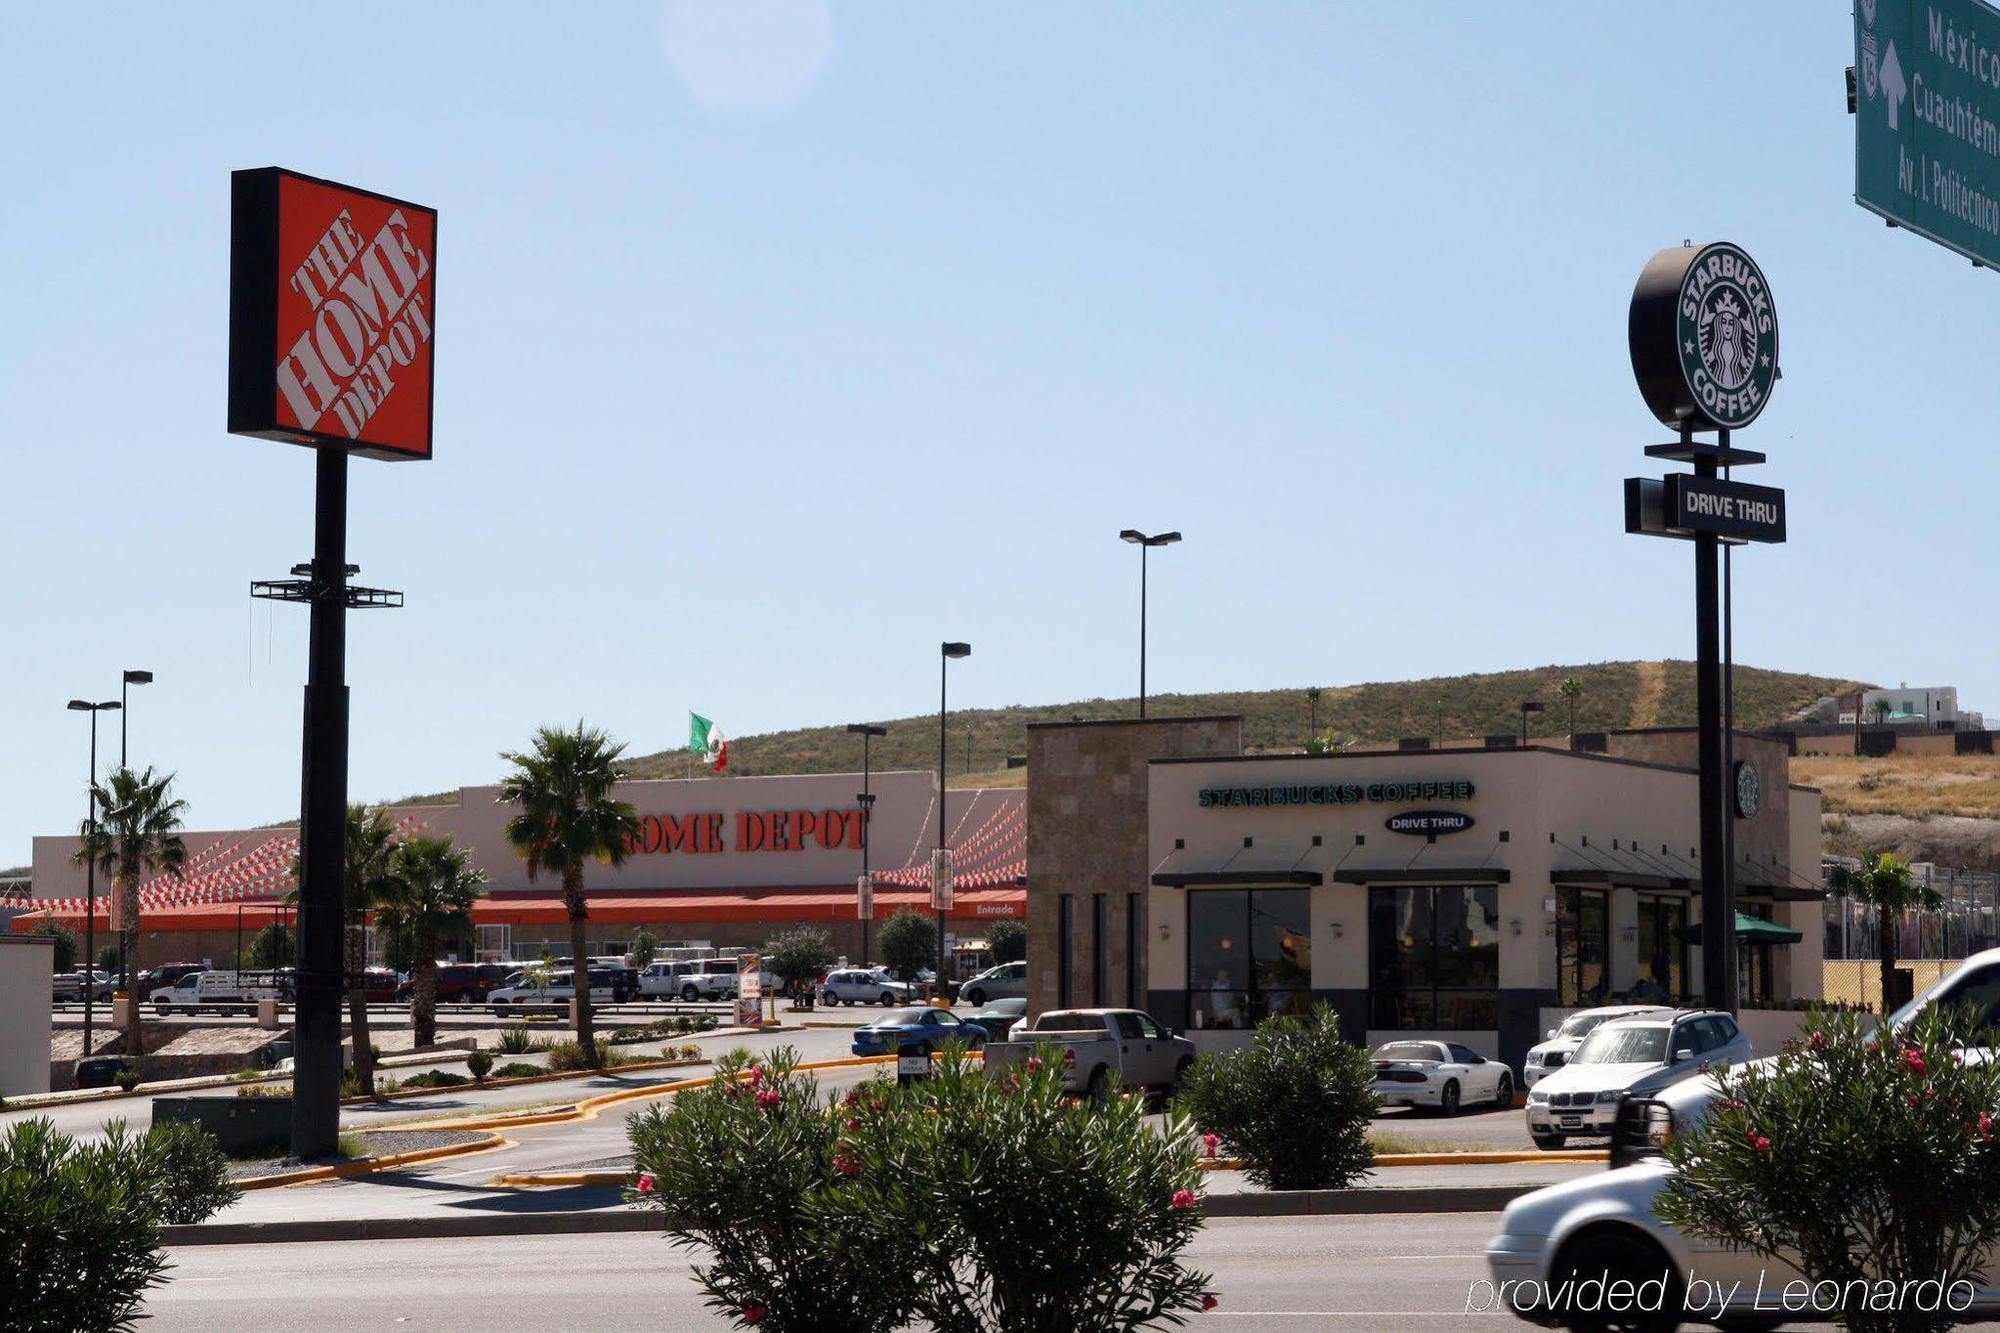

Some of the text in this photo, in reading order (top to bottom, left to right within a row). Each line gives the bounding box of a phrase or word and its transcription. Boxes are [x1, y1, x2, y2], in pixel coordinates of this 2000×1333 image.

[1928, 6, 2000, 89] México
[1913, 72, 2000, 157] Cuauhtém
[1899, 144, 1918, 198] Av.
[1933, 159, 1999, 236] Politécnico
[289, 207, 366, 312] THE
[1683, 253, 1771, 334] STARBUCKS
[276, 208, 430, 431] HOME
[333, 292, 431, 440] DEPOT
[1693, 368, 1762, 418] COFFEE
[1686, 490, 1777, 525] DRIVE THRU
[735, 808, 868, 853] DEPOT
[1199, 780, 1470, 808] STARBUCKS COFFEE
[1391, 817, 1464, 829] DRIVE THRU
[976, 905, 1014, 915] Entrada
